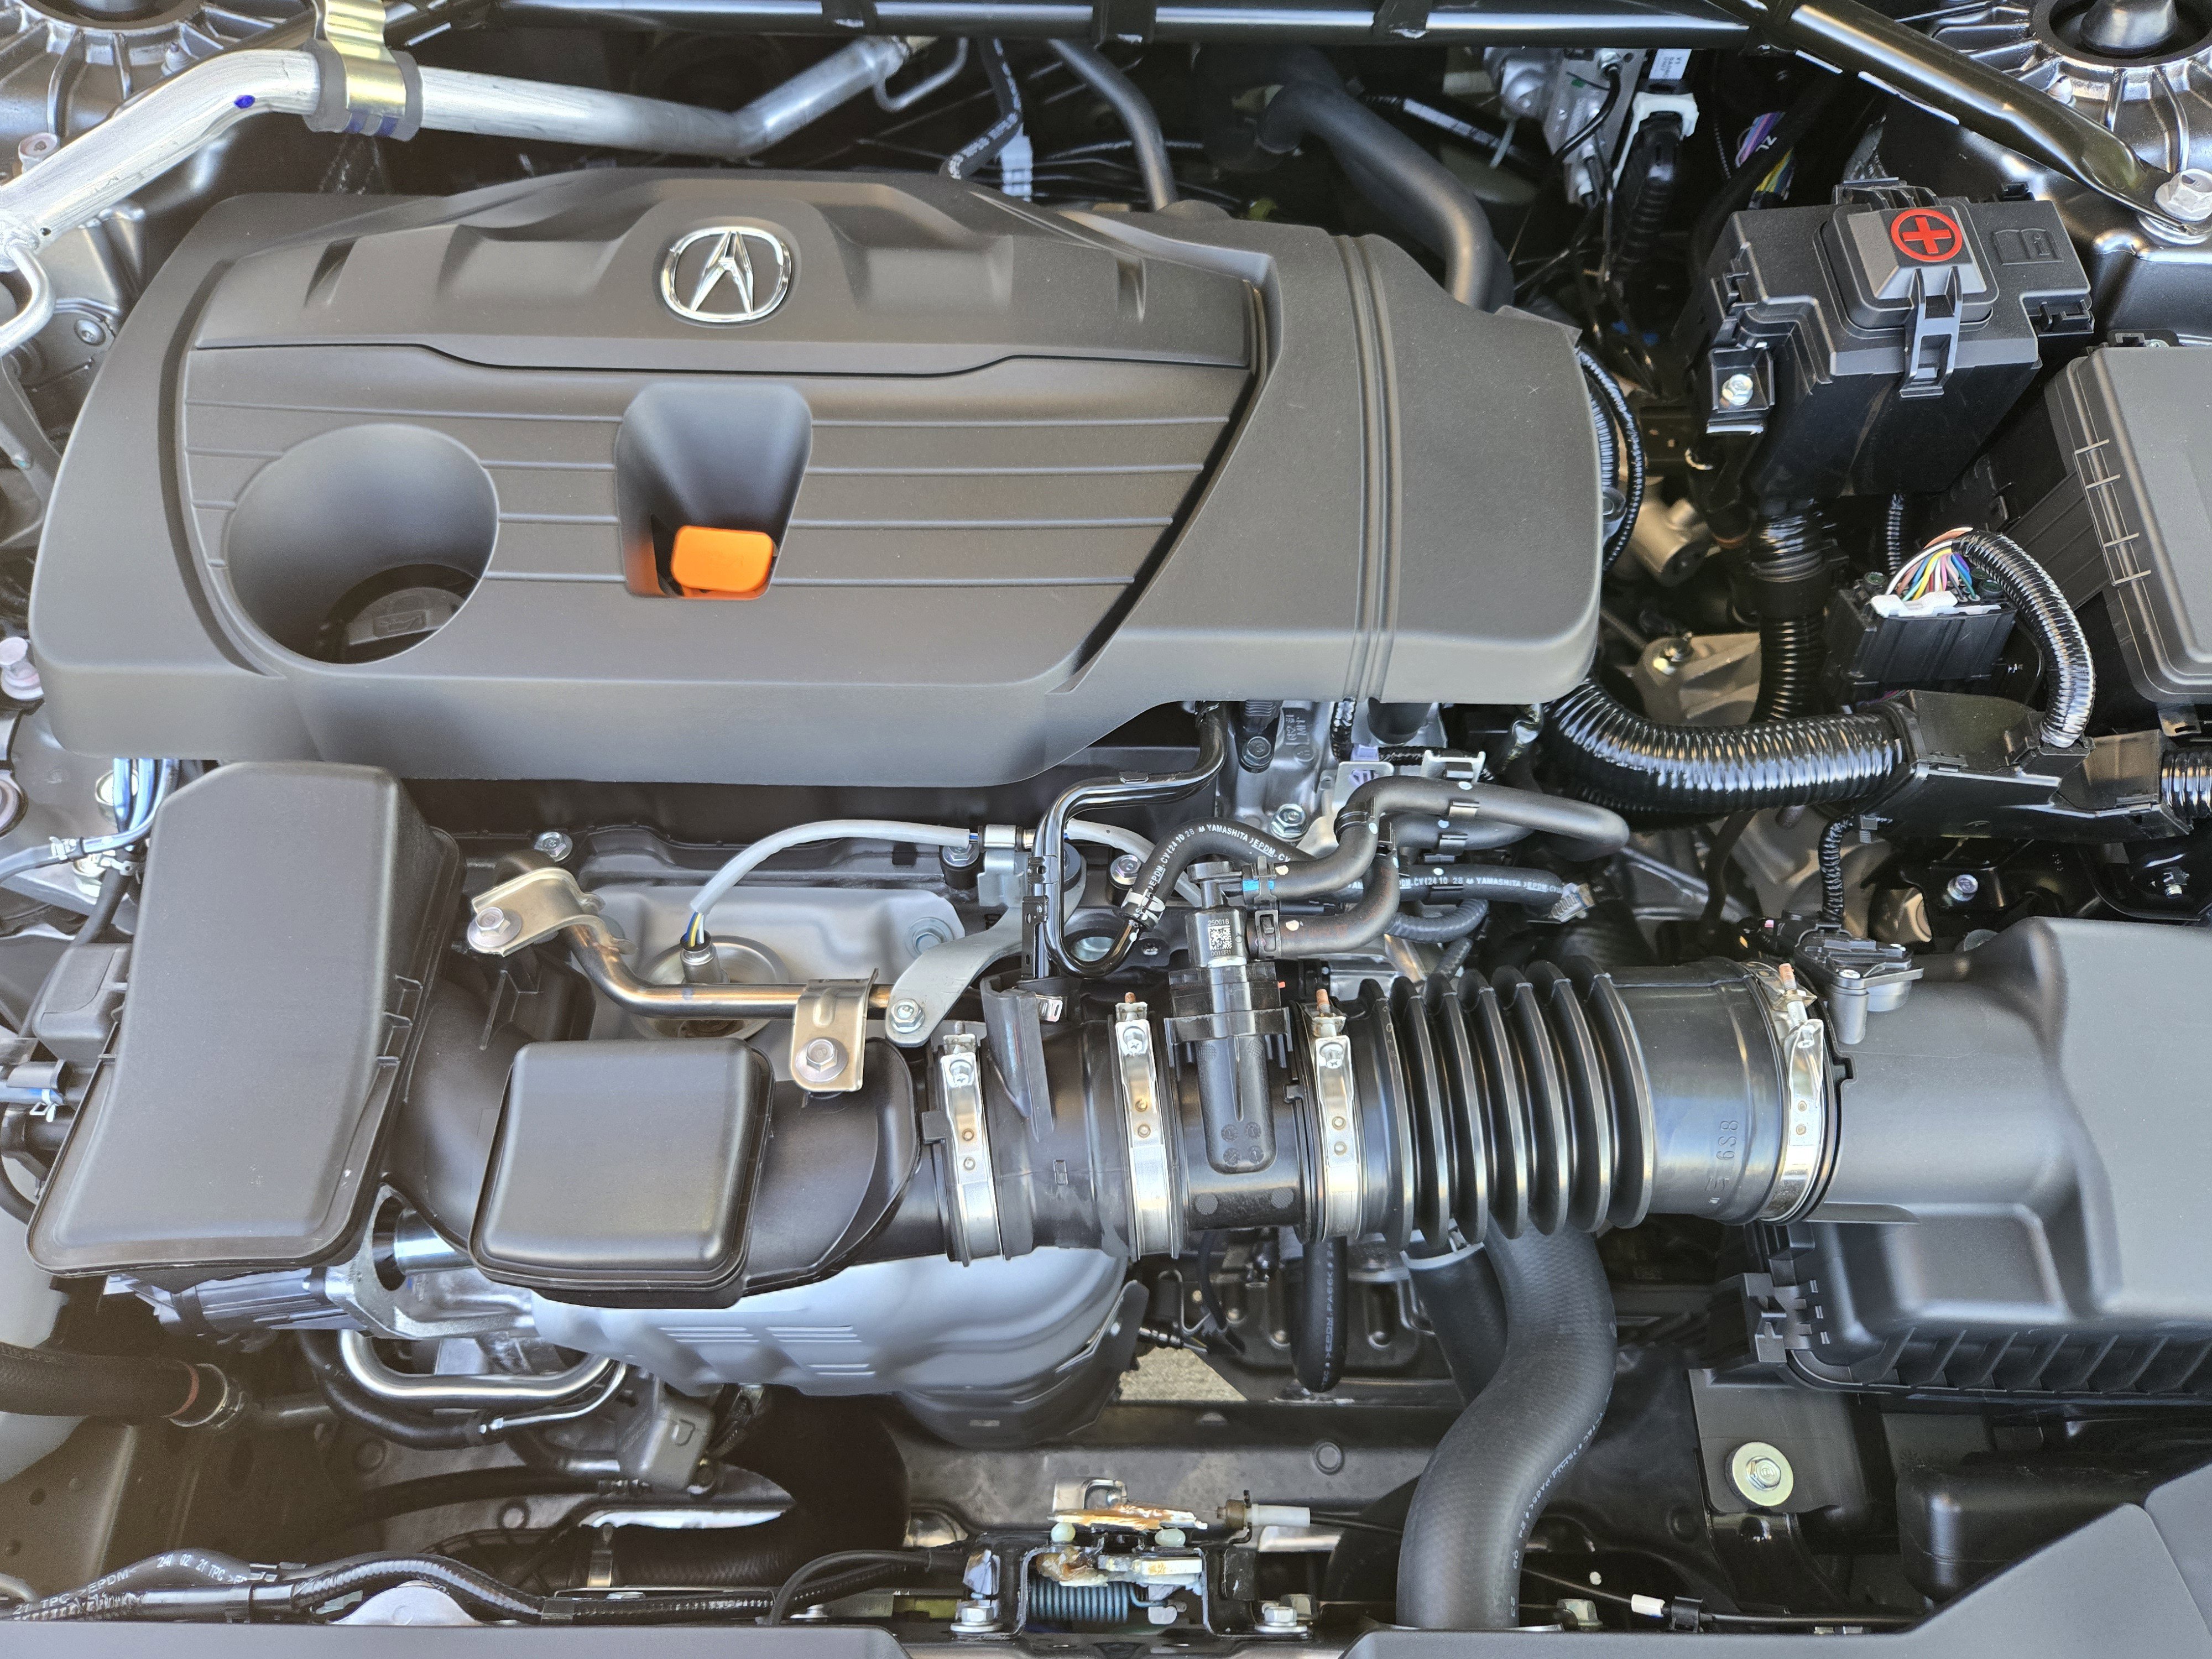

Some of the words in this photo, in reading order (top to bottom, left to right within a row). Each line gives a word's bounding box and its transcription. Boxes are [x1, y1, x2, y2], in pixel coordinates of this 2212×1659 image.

[1206, 824, 1248, 840] YAMASHITA
[1476, 877, 1521, 887] YAMASHITA
[208, 1564, 226, 1582] TPC
[40, 1593, 70, 1609] TPC
